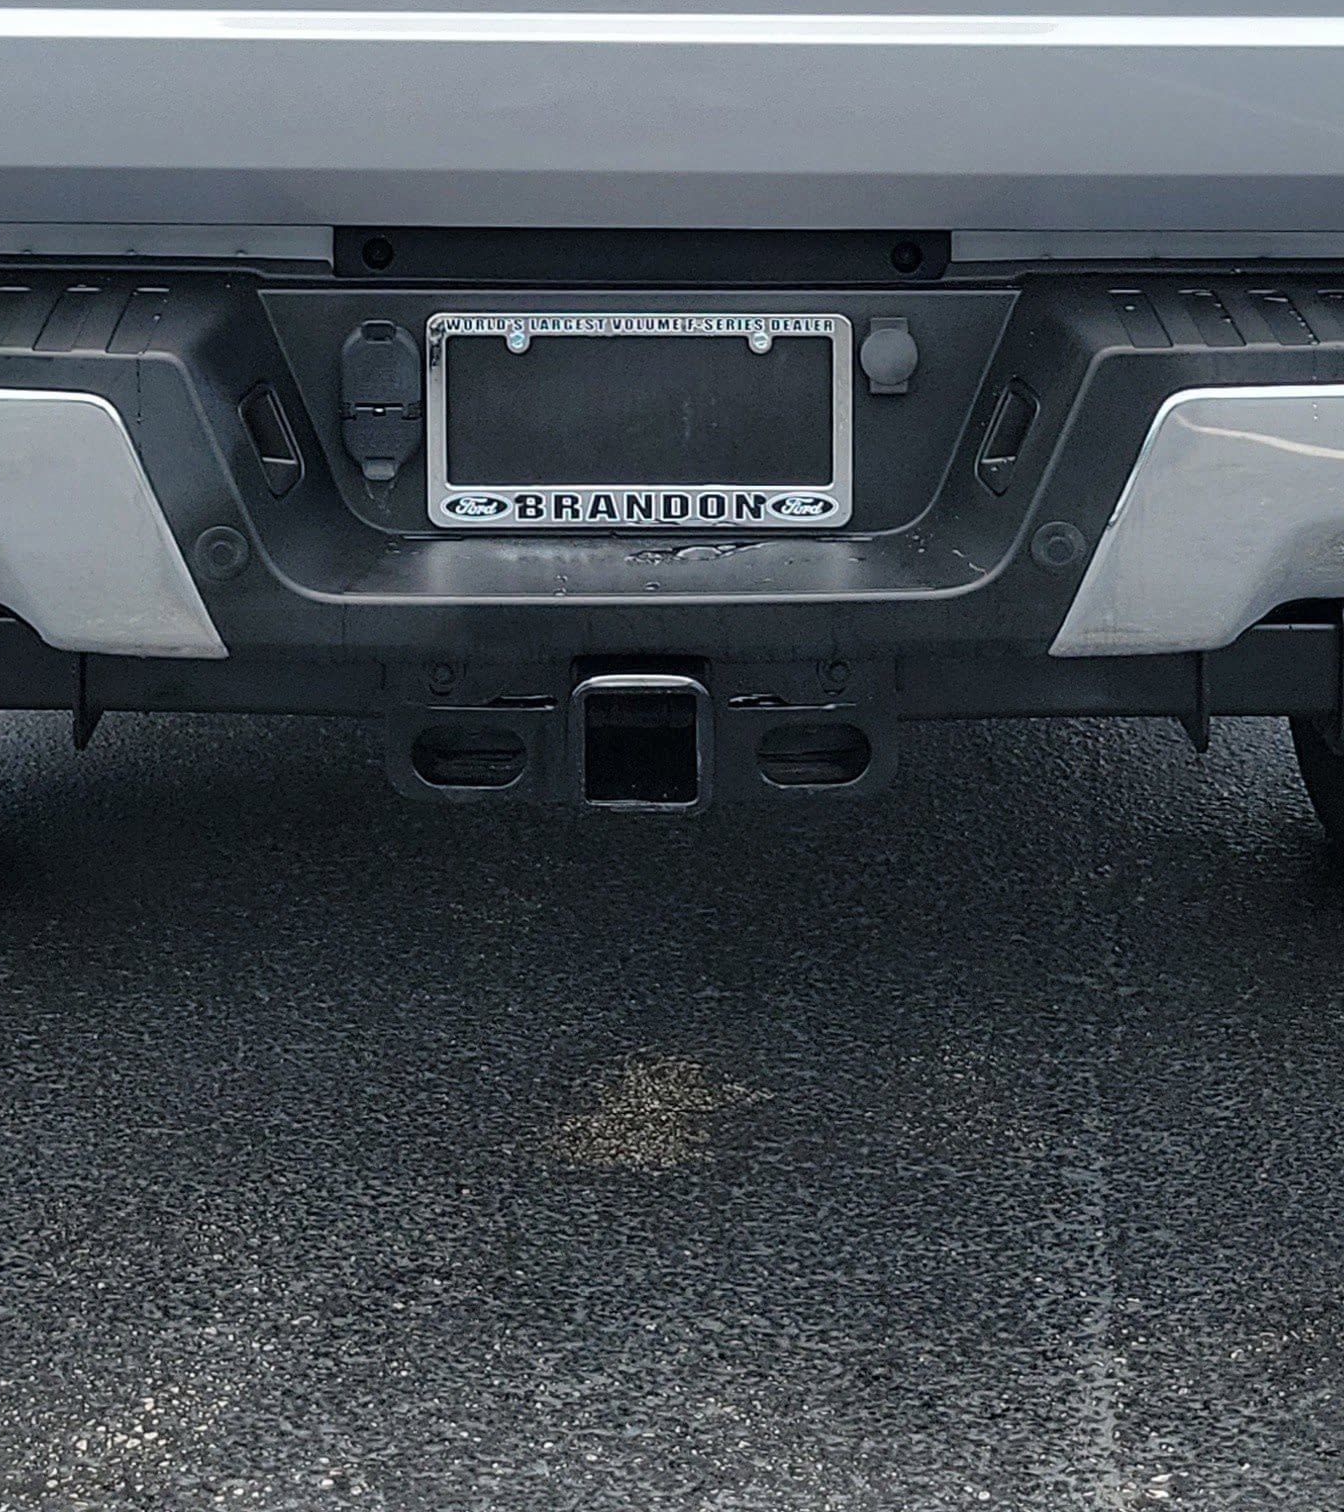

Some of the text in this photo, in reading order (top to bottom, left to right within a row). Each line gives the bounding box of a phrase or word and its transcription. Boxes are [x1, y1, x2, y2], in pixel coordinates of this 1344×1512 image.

[445, 318, 834, 332] WORLD'S LARGEST VOLUME F-SERIES DEALER
[456, 493, 824, 520] Ford BRANDON Ford
